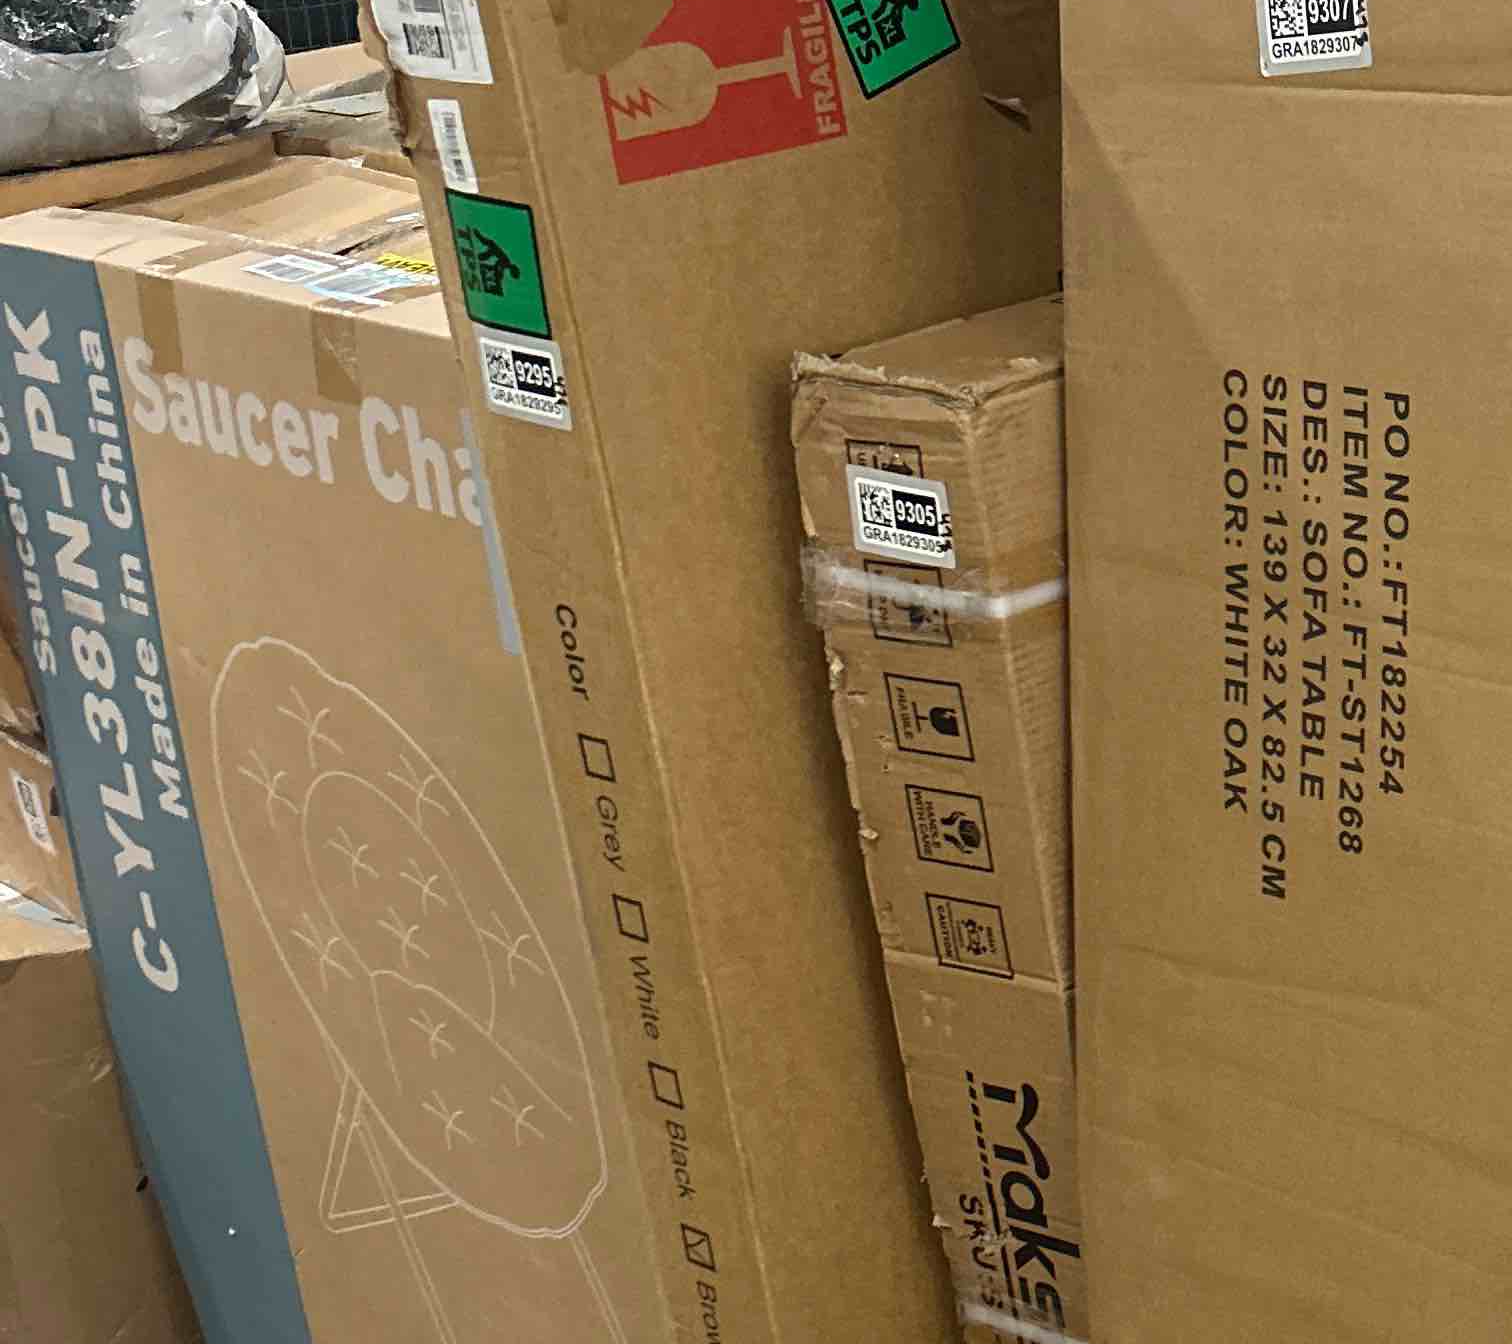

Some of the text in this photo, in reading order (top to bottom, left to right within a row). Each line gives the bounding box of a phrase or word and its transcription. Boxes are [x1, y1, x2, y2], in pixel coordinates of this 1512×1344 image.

[1272, 34, 1359, 59] GRA1829307
[124, 336, 339, 485] Saucer
[514, 360, 553, 388] 9295
[1384, 392, 1410, 458] PO
[863, 526, 945, 555] GRA1829305
[895, 499, 936, 527] 9305
[1, 472, 57, 676] Saucer
[79, 327, 189, 821] Made in China
[1223, 369, 1249, 814] COLOR: WHITE OAK
[1299, 379, 1329, 800] DES.: SOFA TABLE
[554, 602, 591, 702] Color
[1261, 374, 1289, 899] SIZE: 139 X 32 X 82.5 CM
[1338, 386, 1369, 855] ITEM NO.: FT-ST1268
[597, 794, 626, 873] Grey
[628, 956, 661, 1041] White
[664, 1119, 694, 1201] Black
